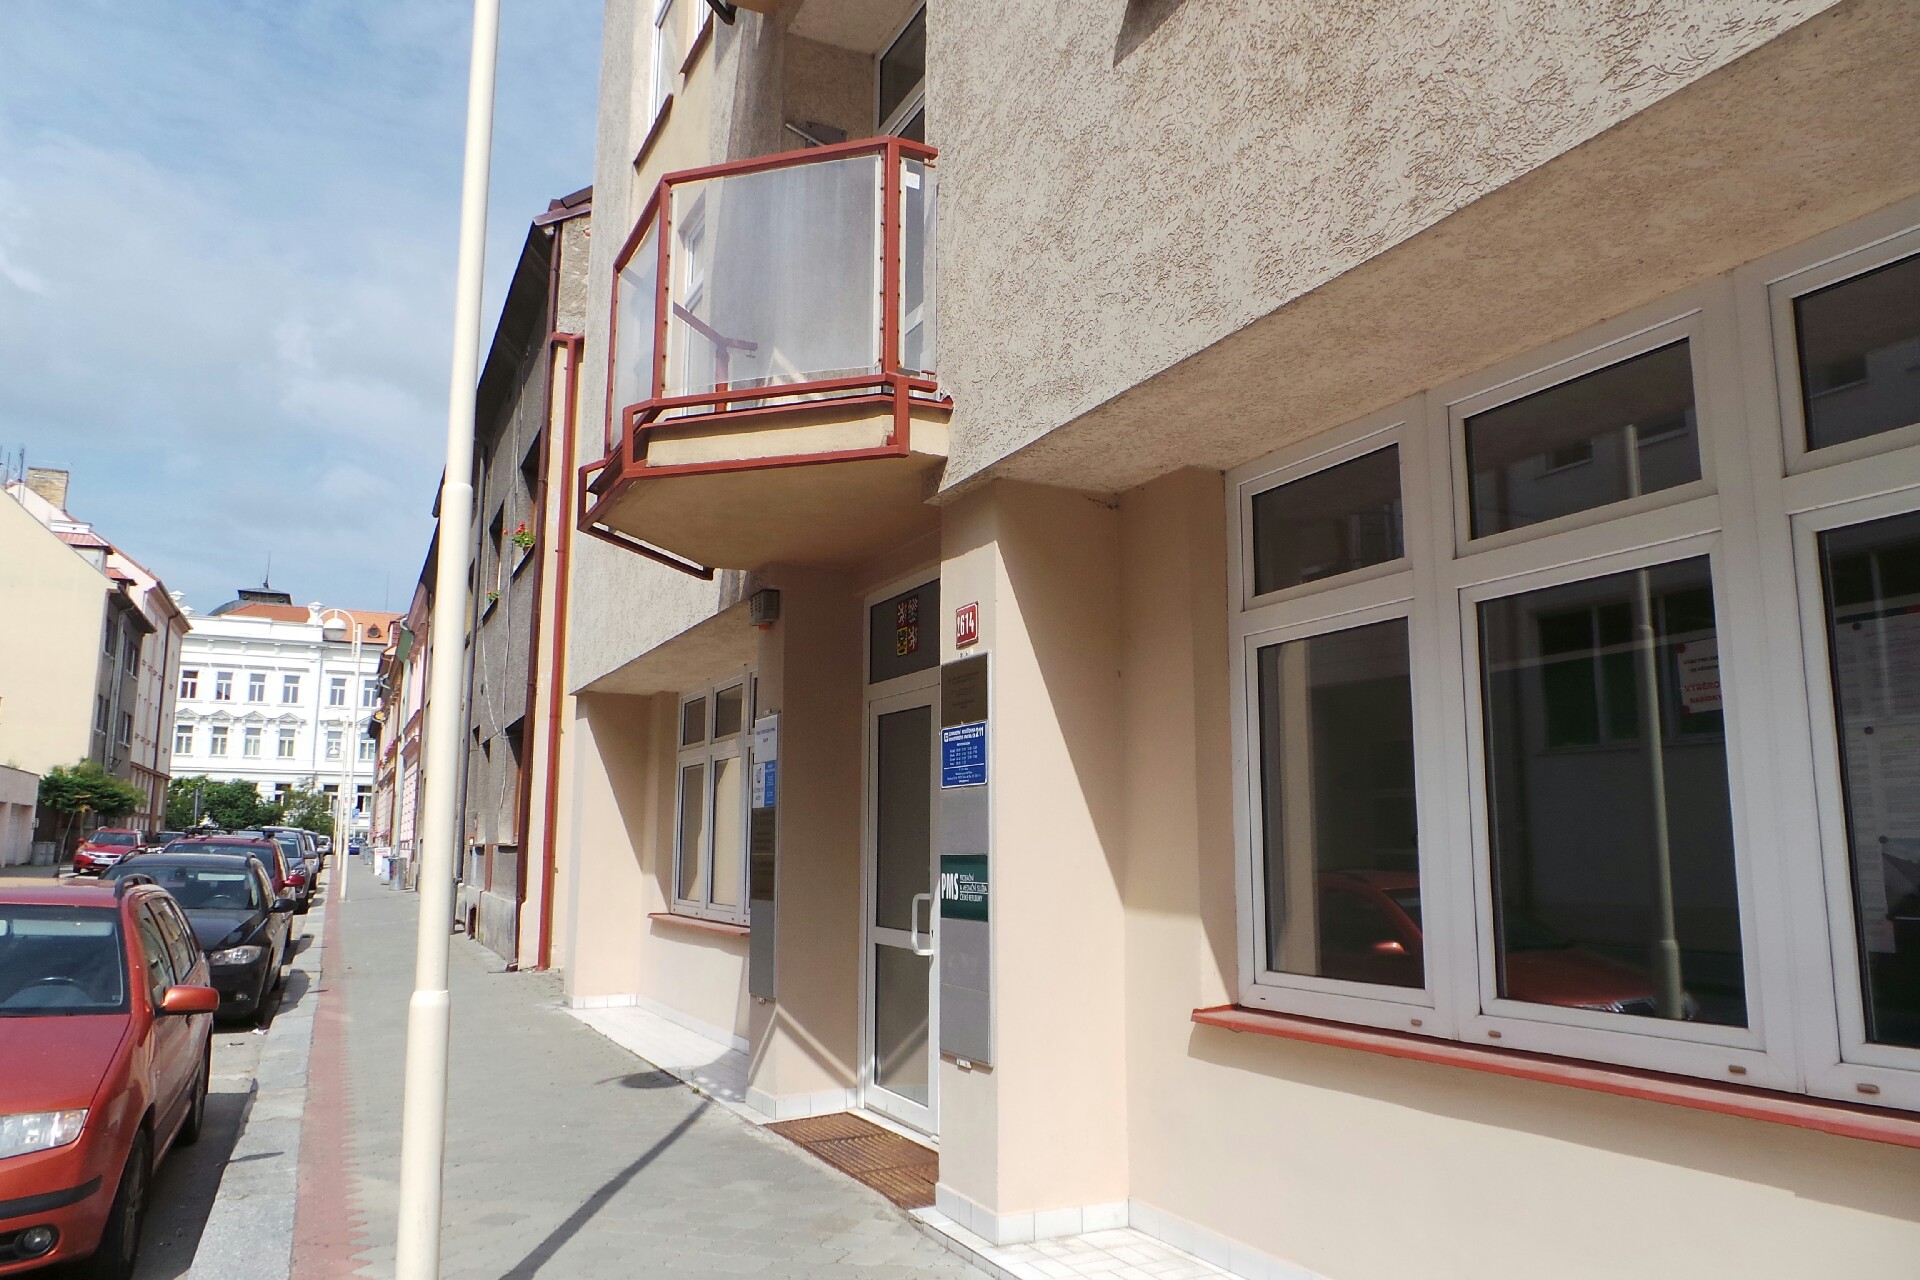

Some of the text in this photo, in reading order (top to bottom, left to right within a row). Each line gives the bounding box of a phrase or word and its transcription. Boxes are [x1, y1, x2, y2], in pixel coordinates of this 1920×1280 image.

[956, 611, 975, 638] 2614
[976, 726, 984, 738] 211
[941, 873, 959, 900] PMS
